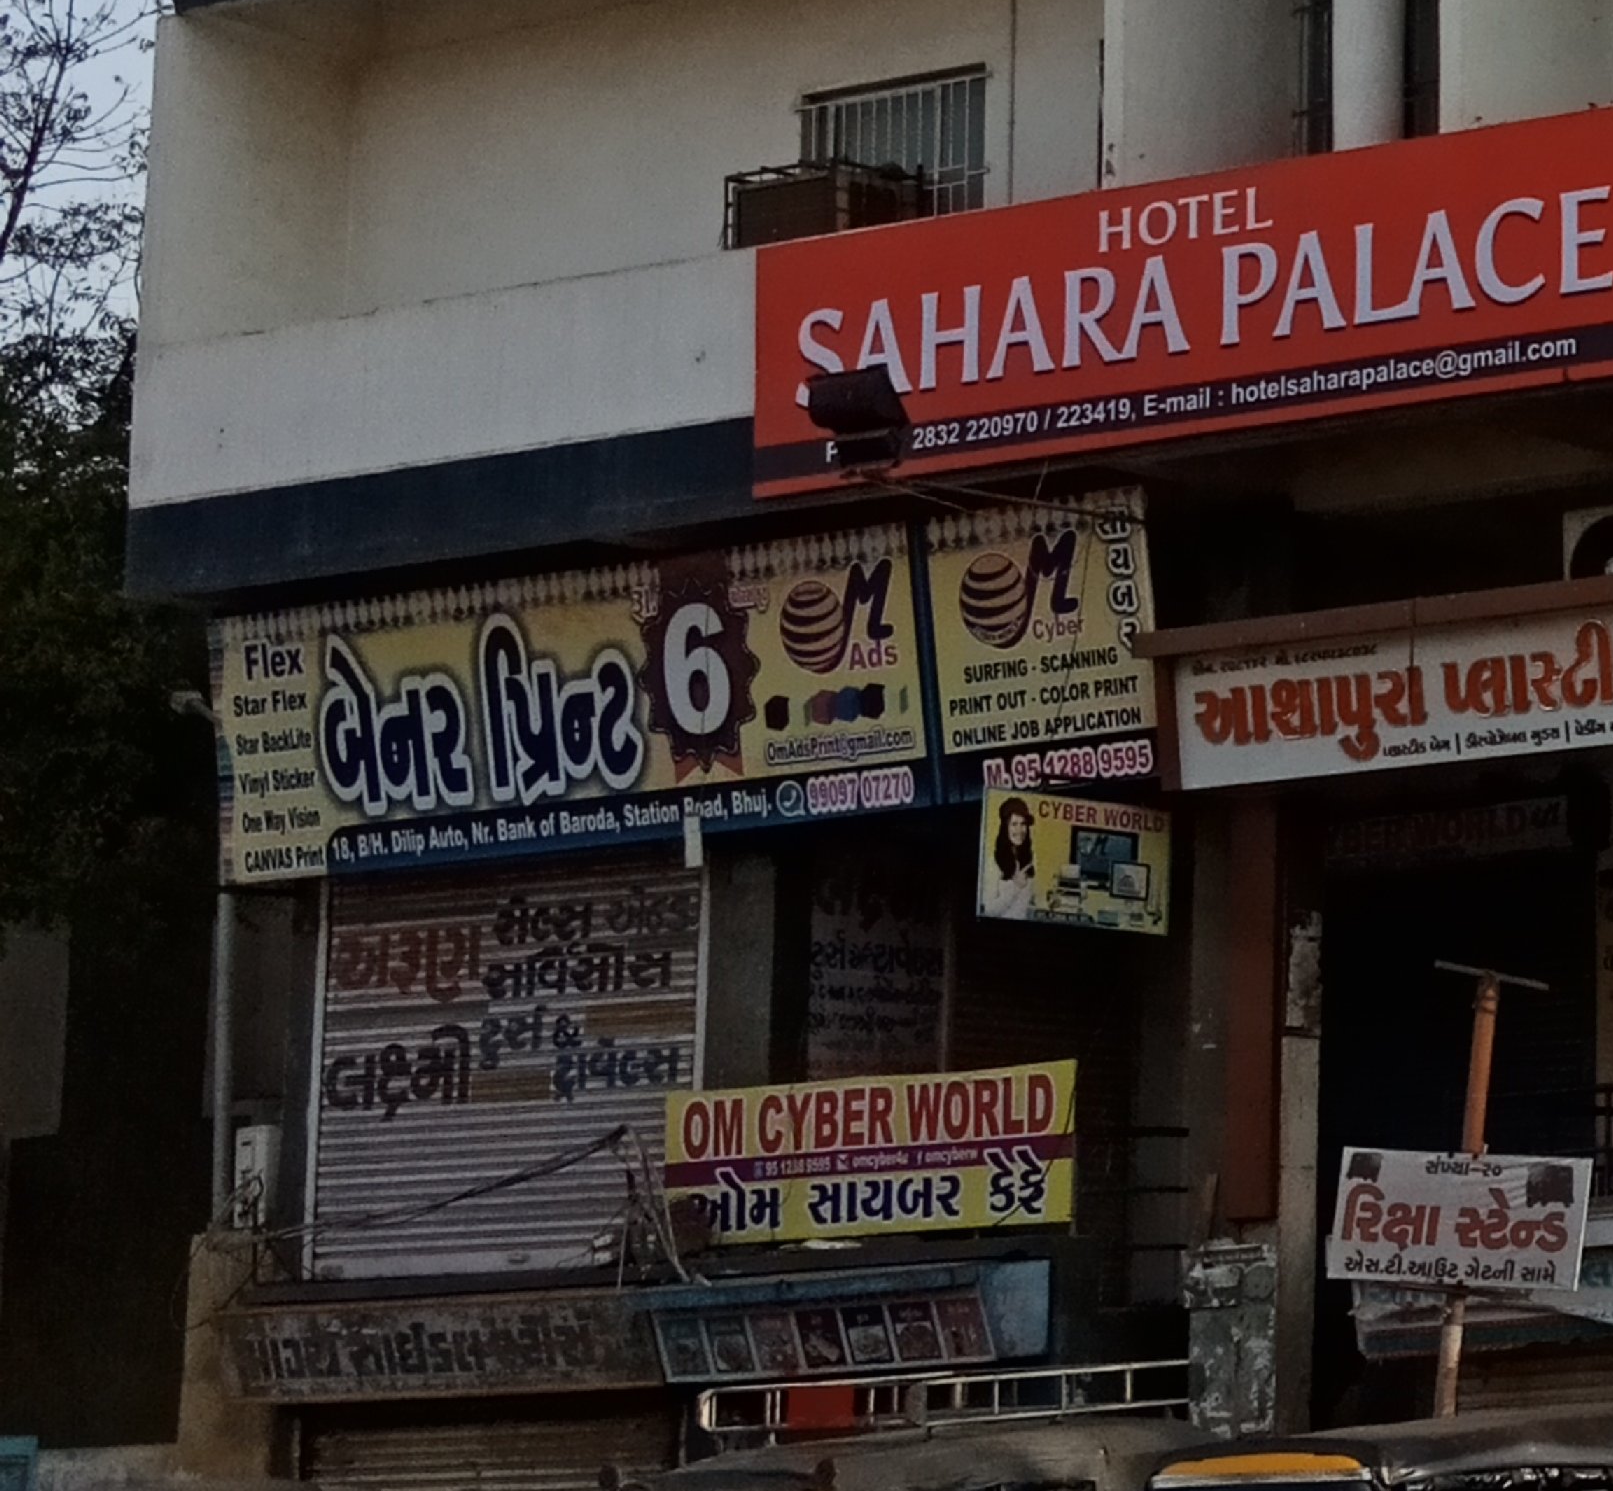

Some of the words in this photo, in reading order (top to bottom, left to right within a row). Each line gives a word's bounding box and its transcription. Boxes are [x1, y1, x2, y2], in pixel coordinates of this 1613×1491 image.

[1097, 186, 1273, 254] HOTEL
[795, 254, 1191, 409] SAHARA
[964, 410, 1039, 446] 220970
[1056, 395, 1137, 430] 223419,
[1142, 386, 1213, 421] E-mail
[1229, 333, 1578, 409] hotelsaharapalace@gmail.com
[1032, 616, 1084, 644] Cyber
[244, 641, 304, 681] Flex
[663, 602, 732, 735] 6
[849, 640, 899, 672] Ads
[964, 659, 1028, 684] SURFING
[1040, 648, 1119, 677] SCANNING
[233, 694, 268, 718] Star
[271, 688, 307, 712] Flex
[321, 635, 472, 814] બેનર
[481, 615, 643, 805] પ્રિન્ટ
[949, 694, 993, 718] PRINT
[996, 691, 1028, 714] OUT
[1039, 684, 1091, 707] COLOR
[1095, 676, 1140, 701] PRINT
[1194, 665, 1428, 761] આશાપુરા
[235, 734, 261, 756] Star
[262, 730, 312, 753] BackLite
[953, 725, 1007, 749] ONLINE
[1010, 721, 1041, 743] JOB
[1044, 707, 1142, 740] APPLICATION
[239, 775, 270, 797] Vinyl
[272, 769, 315, 792] Sticker
[242, 812, 260, 833] One
[261, 810, 285, 834] Way
[285, 807, 320, 830] Vision
[392, 827, 425, 856] Dilip
[428, 823, 468, 852] Auto,
[471, 820, 493, 846] Nr.
[496, 814, 537, 842] Bank
[541, 811, 556, 836] of
[559, 805, 621, 836] Baroda,
[624, 797, 682, 828] Station
[731, 788, 772, 818] Bhuj.
[859, 766, 915, 808] 07270
[1038, 800, 1098, 824] CYBER
[1103, 808, 1165, 833] WORLD
[244, 845, 294, 872] CANVAS
[296, 843, 325, 868] Print
[554, 1014, 582, 1049] &
[683, 1098, 744, 1160] OM
[758, 1087, 894, 1155] CYBER
[907, 1073, 1055, 1145] WORLD
[808, 1174, 961, 1225] સાયબર
[984, 1146, 1045, 1217] કેફે
[1341, 1183, 1441, 1252] રિક્ષા
[1454, 1187, 1569, 1253] સ્ટેન્ડ
[1520, 1259, 1557, 1284] સામે
